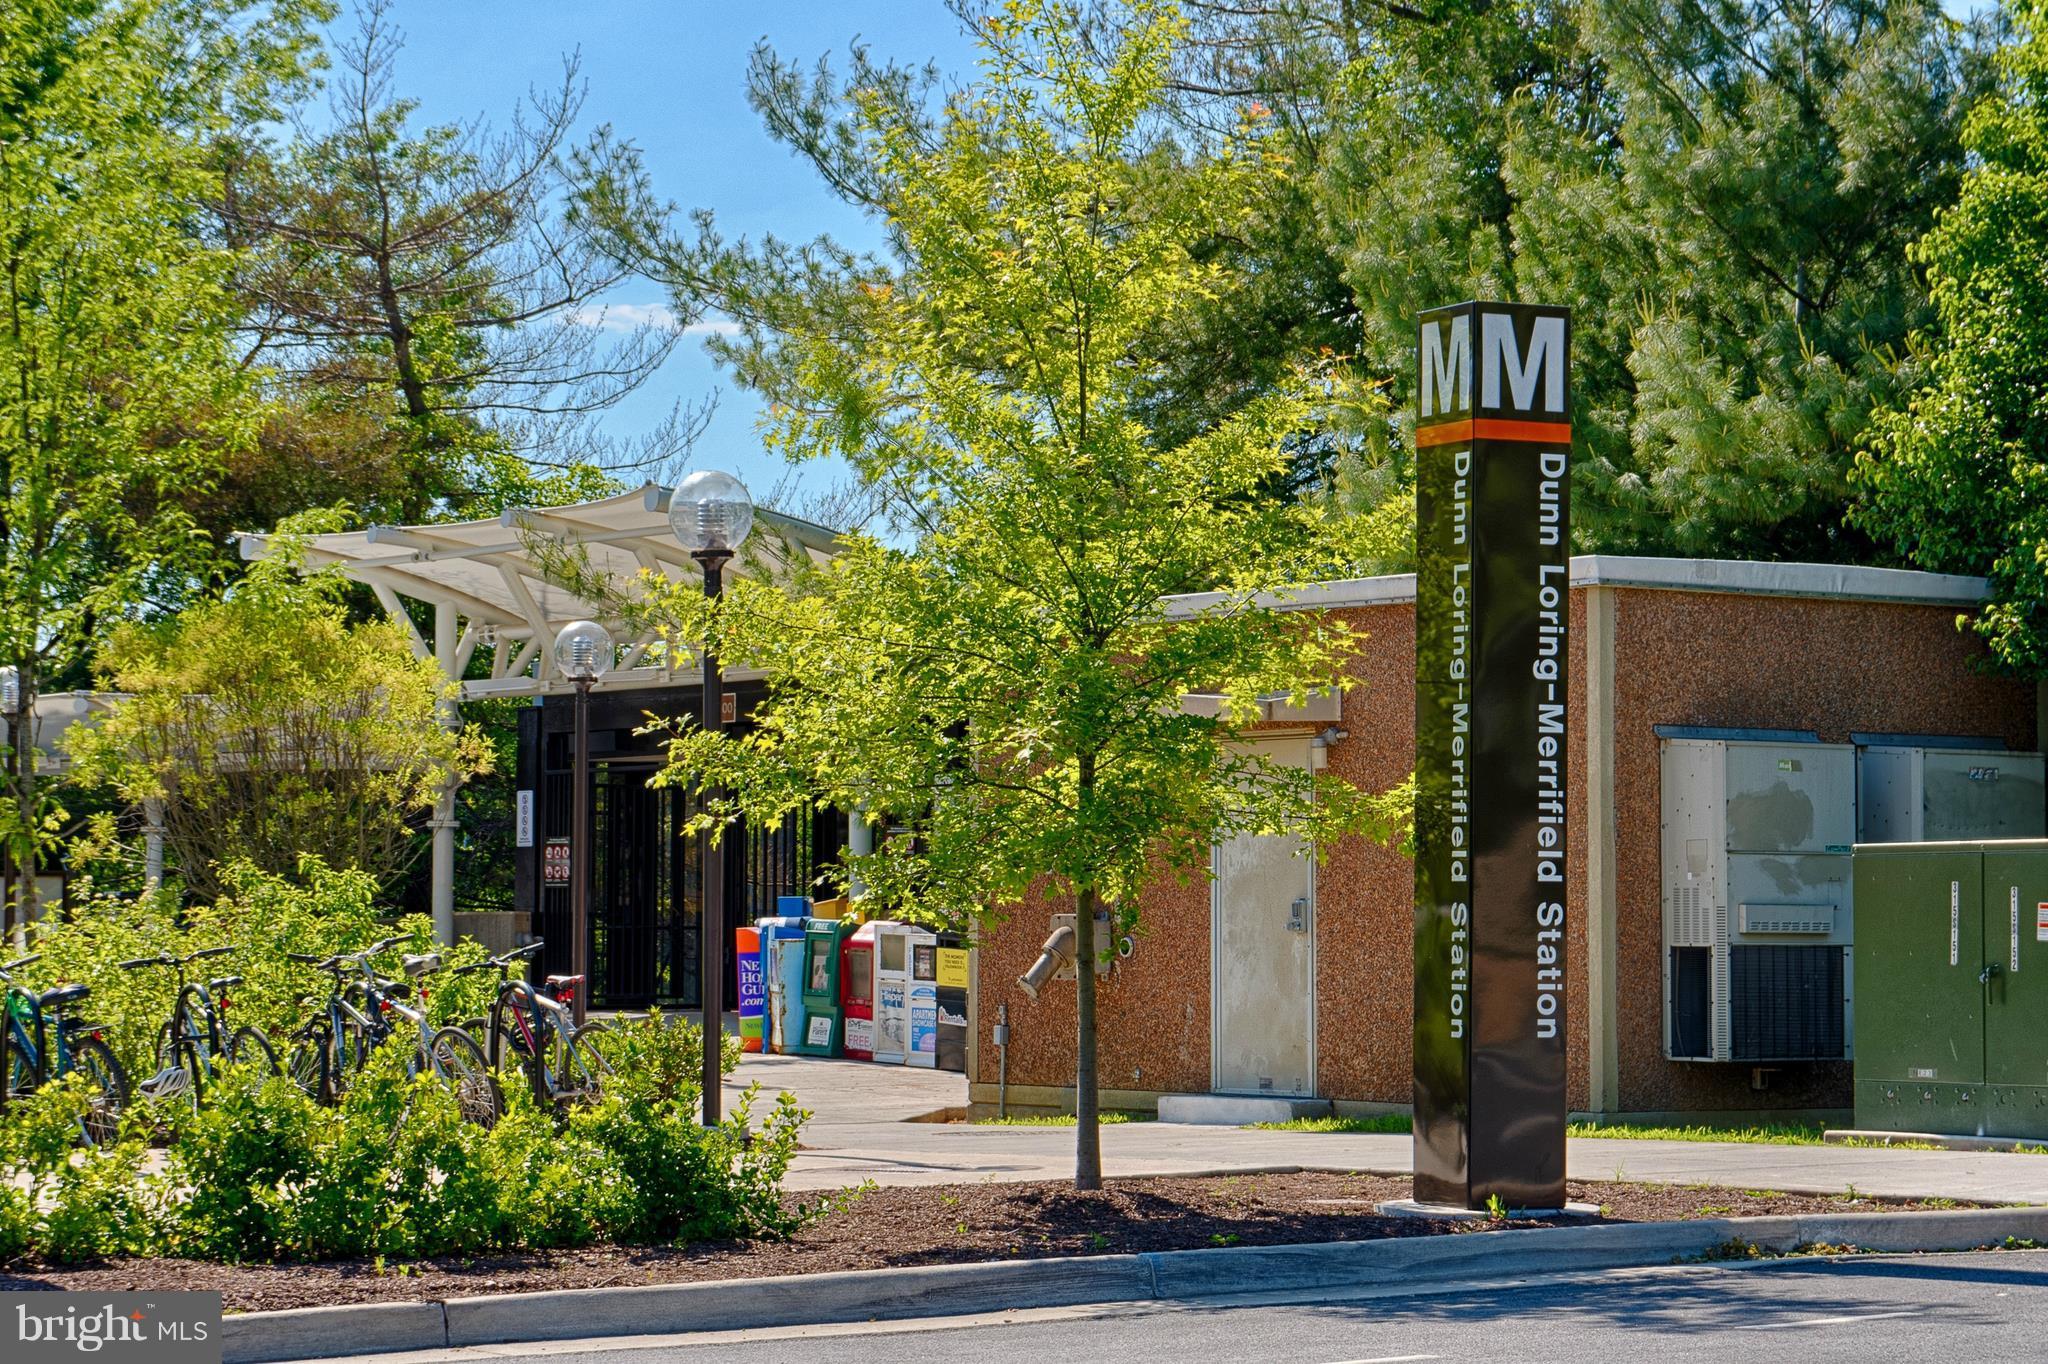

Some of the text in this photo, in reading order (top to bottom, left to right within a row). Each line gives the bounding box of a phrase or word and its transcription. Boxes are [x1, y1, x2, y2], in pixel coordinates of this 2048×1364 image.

[1421, 314, 1470, 418] M
[1481, 312, 1566, 413] M
[1450, 450, 1471, 1038] Dunn Loring-Merrifield Station
[1533, 453, 1566, 1038] Dunn Loring-Merrifield Station
[741, 960, 760, 972] NE
[741, 984, 765, 996] GUI
[742, 972, 763, 984] HO
[848, 1034, 870, 1048] FREE
